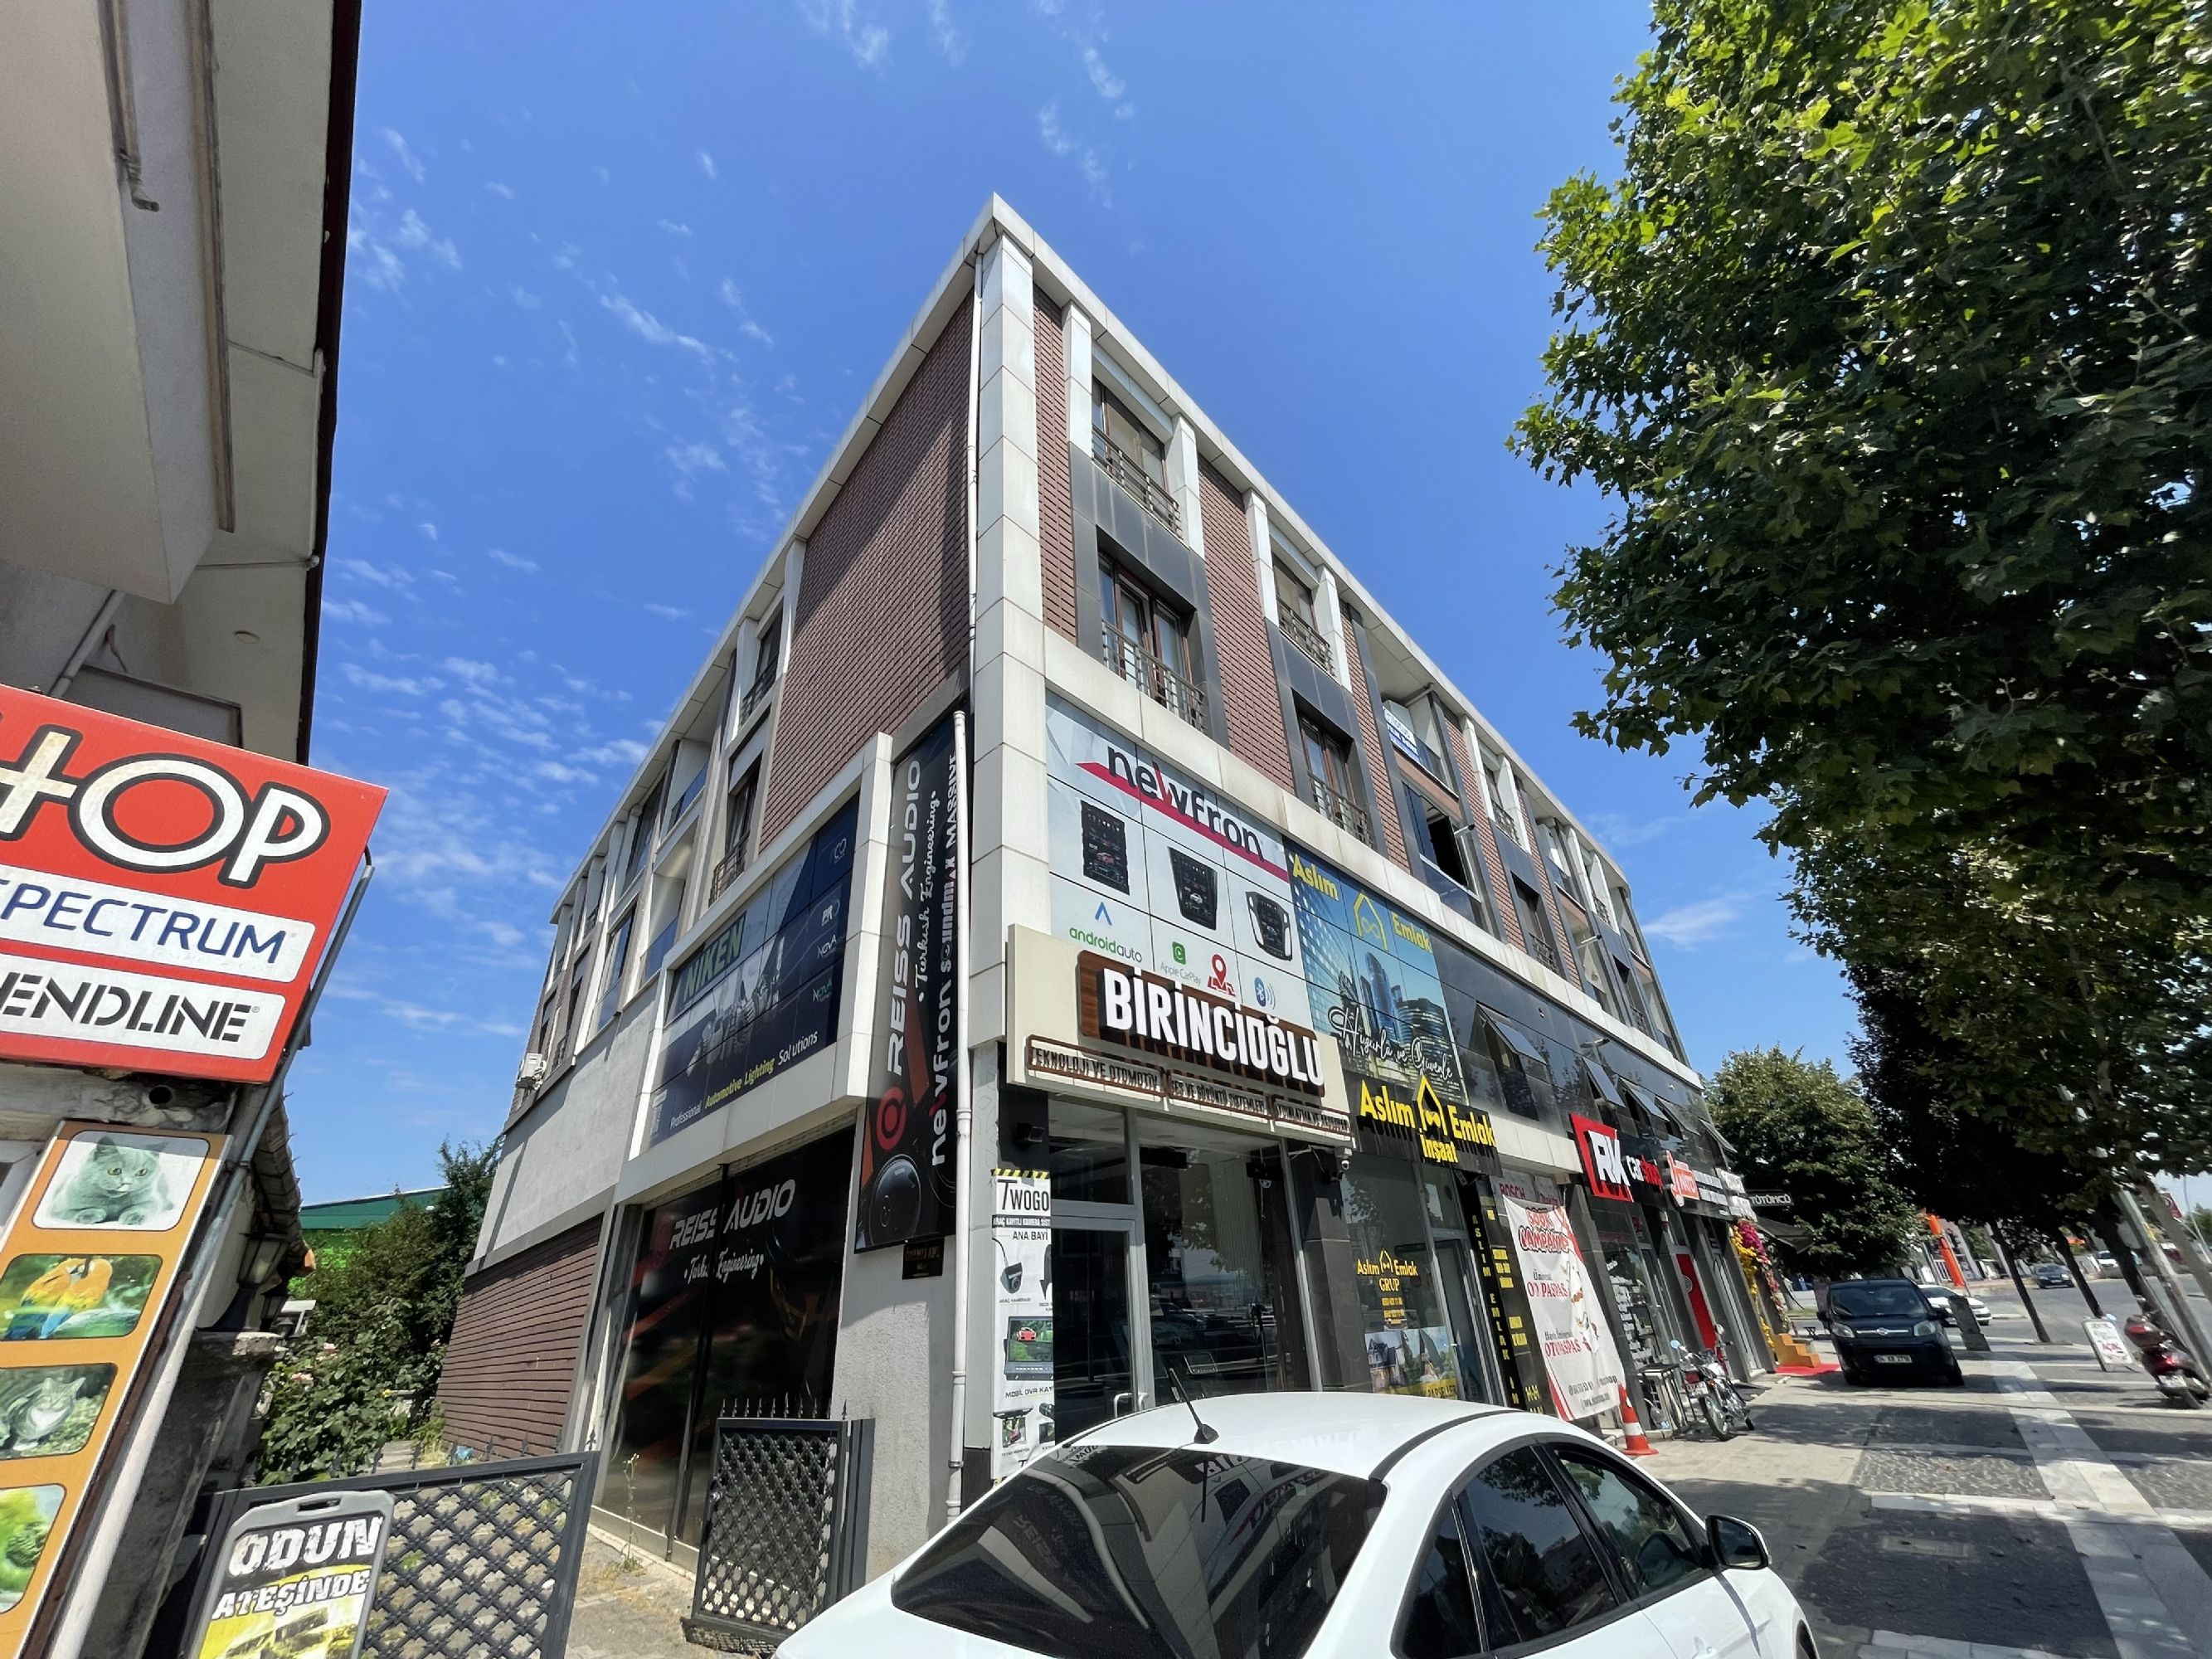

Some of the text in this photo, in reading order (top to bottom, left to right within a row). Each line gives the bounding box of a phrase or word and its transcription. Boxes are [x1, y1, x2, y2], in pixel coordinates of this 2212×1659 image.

[0, 879, 287, 964] PECTRUM
[887, 760, 921, 1076] REISS AUDIO
[1391, 910, 1433, 954] Emlak
[683, 912, 746, 1002] NIKEN
[915, 906, 931, 990] Turkish
[1160, 962, 1179, 978] Apple
[1102, 966, 1325, 1087] BİRİNCİOĞLU
[669, 1100, 702, 1130] Professional
[704, 1078, 742, 1110] Automotive
[744, 1058, 775, 1086] Lighting
[778, 1031, 819, 1066] Solutions
[1091, 1060, 1106, 1078] VE
[1418, 1127, 1459, 1163] İnşaat
[1447, 1104, 1497, 1147] Emlak
[723, 1179, 796, 1234] AUDIO
[1013, 1228, 1048, 1241] ANA BAYİ
[1378, 1277, 1401, 1292] GRUP
[1393, 1259, 1419, 1277] Emlak
[228, 1515, 384, 1577] ODUN
[211, 1570, 372, 1617] ATEŞİNDE
